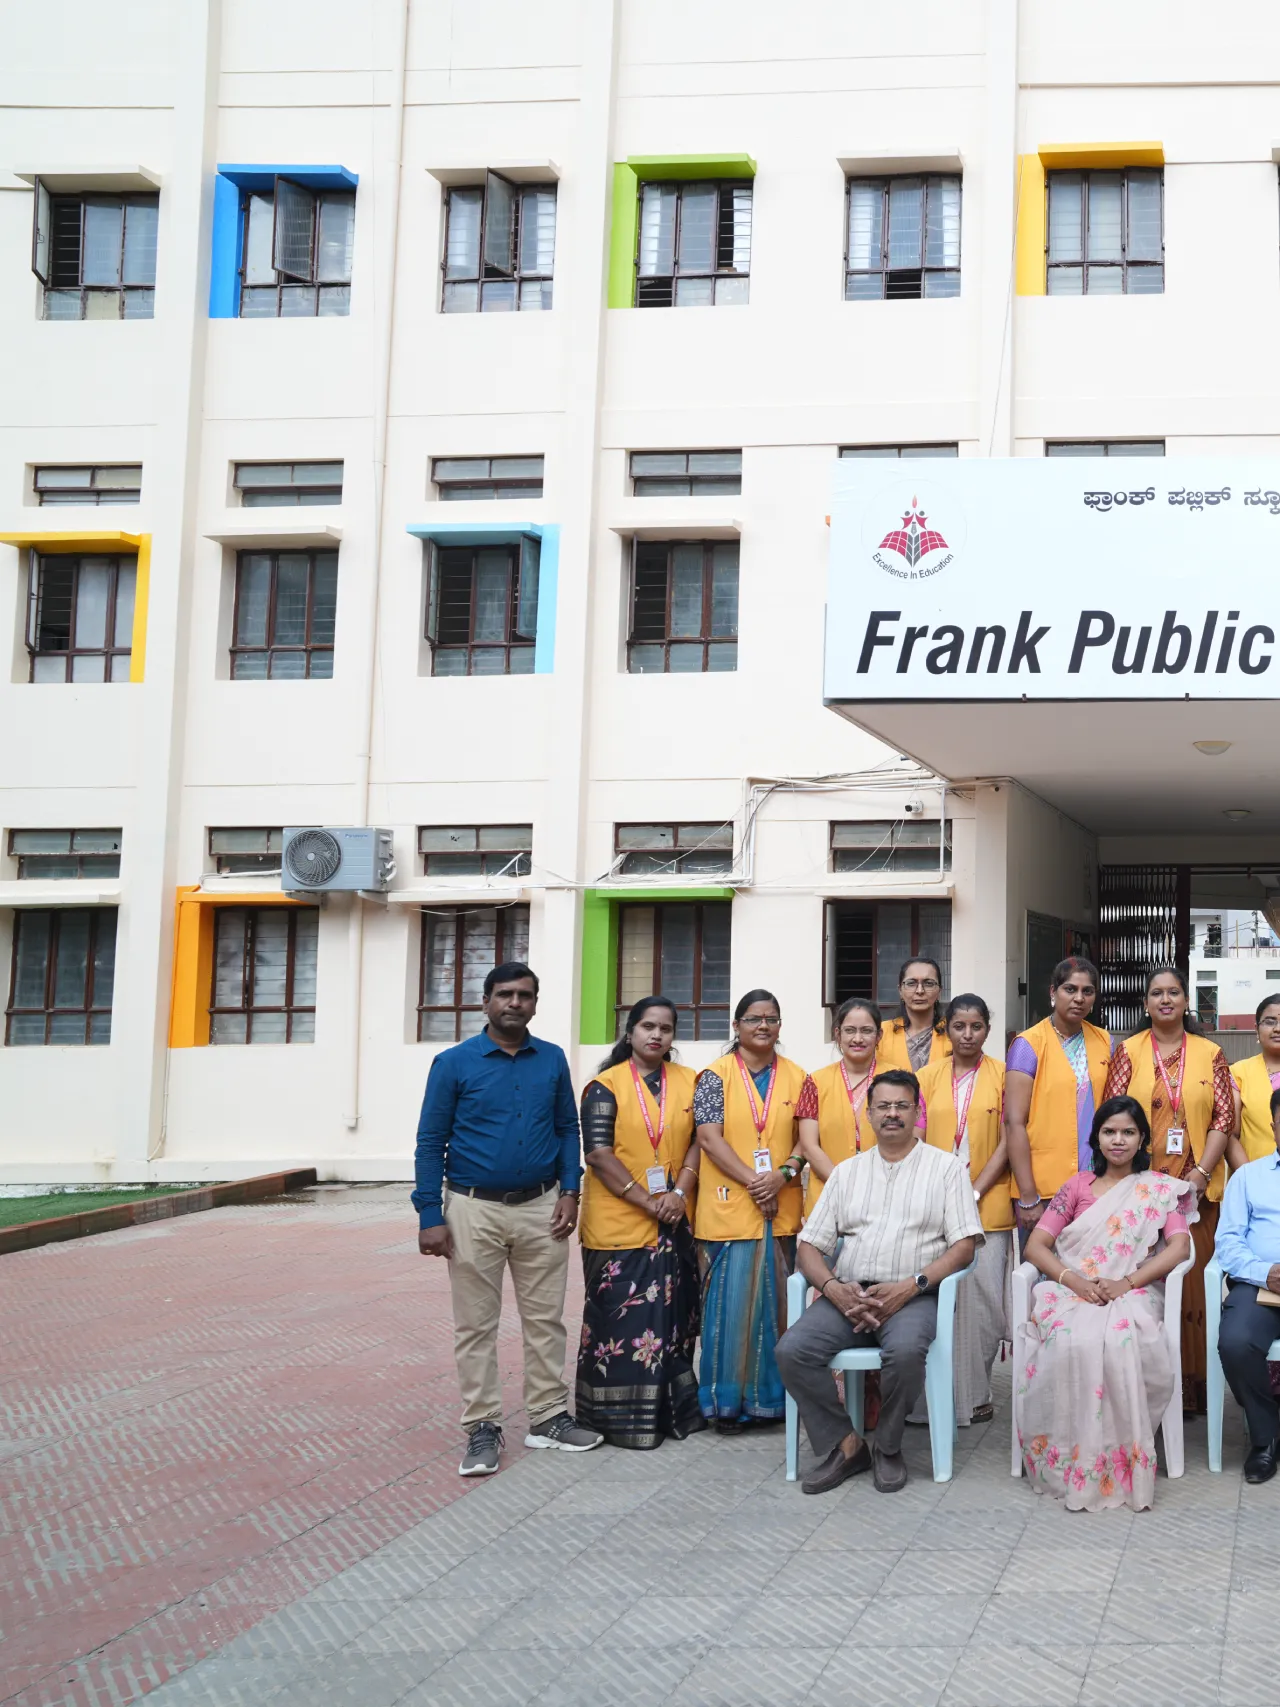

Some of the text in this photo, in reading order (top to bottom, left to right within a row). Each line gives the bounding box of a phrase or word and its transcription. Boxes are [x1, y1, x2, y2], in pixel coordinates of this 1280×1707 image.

[1084, 487, 1155, 512] ಫ್ರಾಂಕ್
[1168, 486, 1232, 512] ಪಬ್ಲಿಕ್
[872, 552, 954, 579] Excellence In Education
[857, 611, 1051, 674] Frank
[1068, 611, 1274, 674] Public
